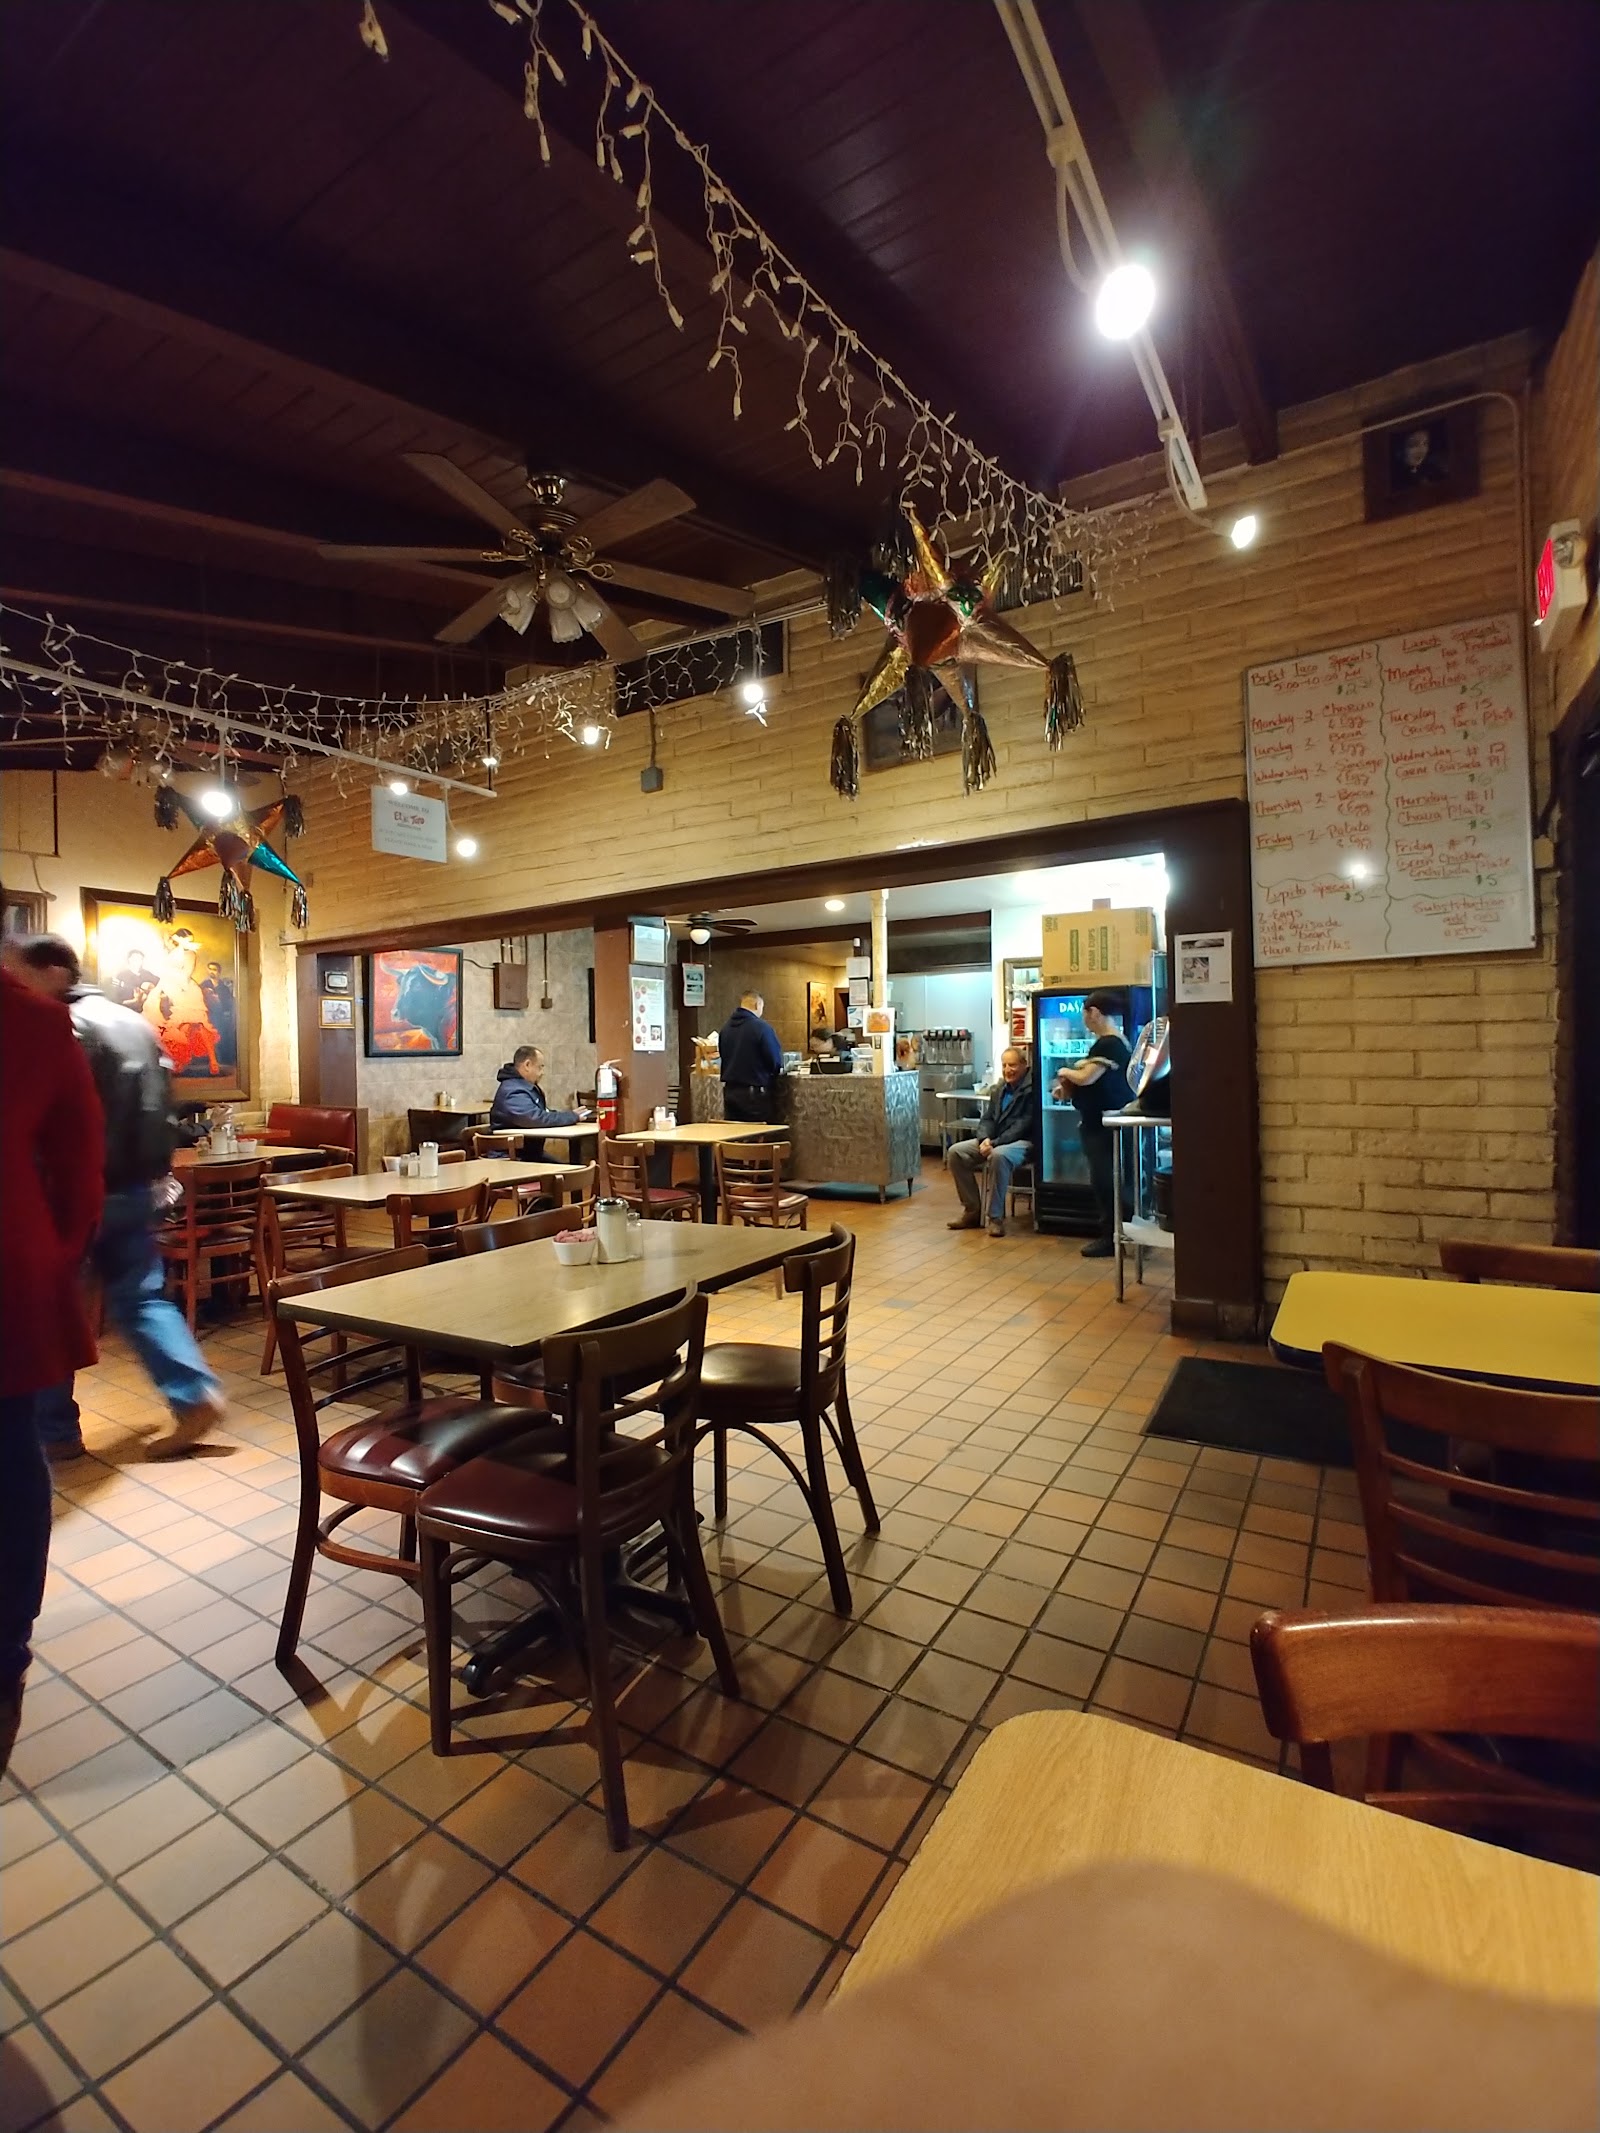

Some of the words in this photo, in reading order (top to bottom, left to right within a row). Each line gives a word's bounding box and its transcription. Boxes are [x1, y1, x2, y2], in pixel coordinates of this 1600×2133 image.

[1252, 714, 1295, 734] Monday
[1386, 707, 1436, 728] Tuesday
[1256, 832, 1294, 852] Friday
[1396, 838, 1435, 858] Friday
